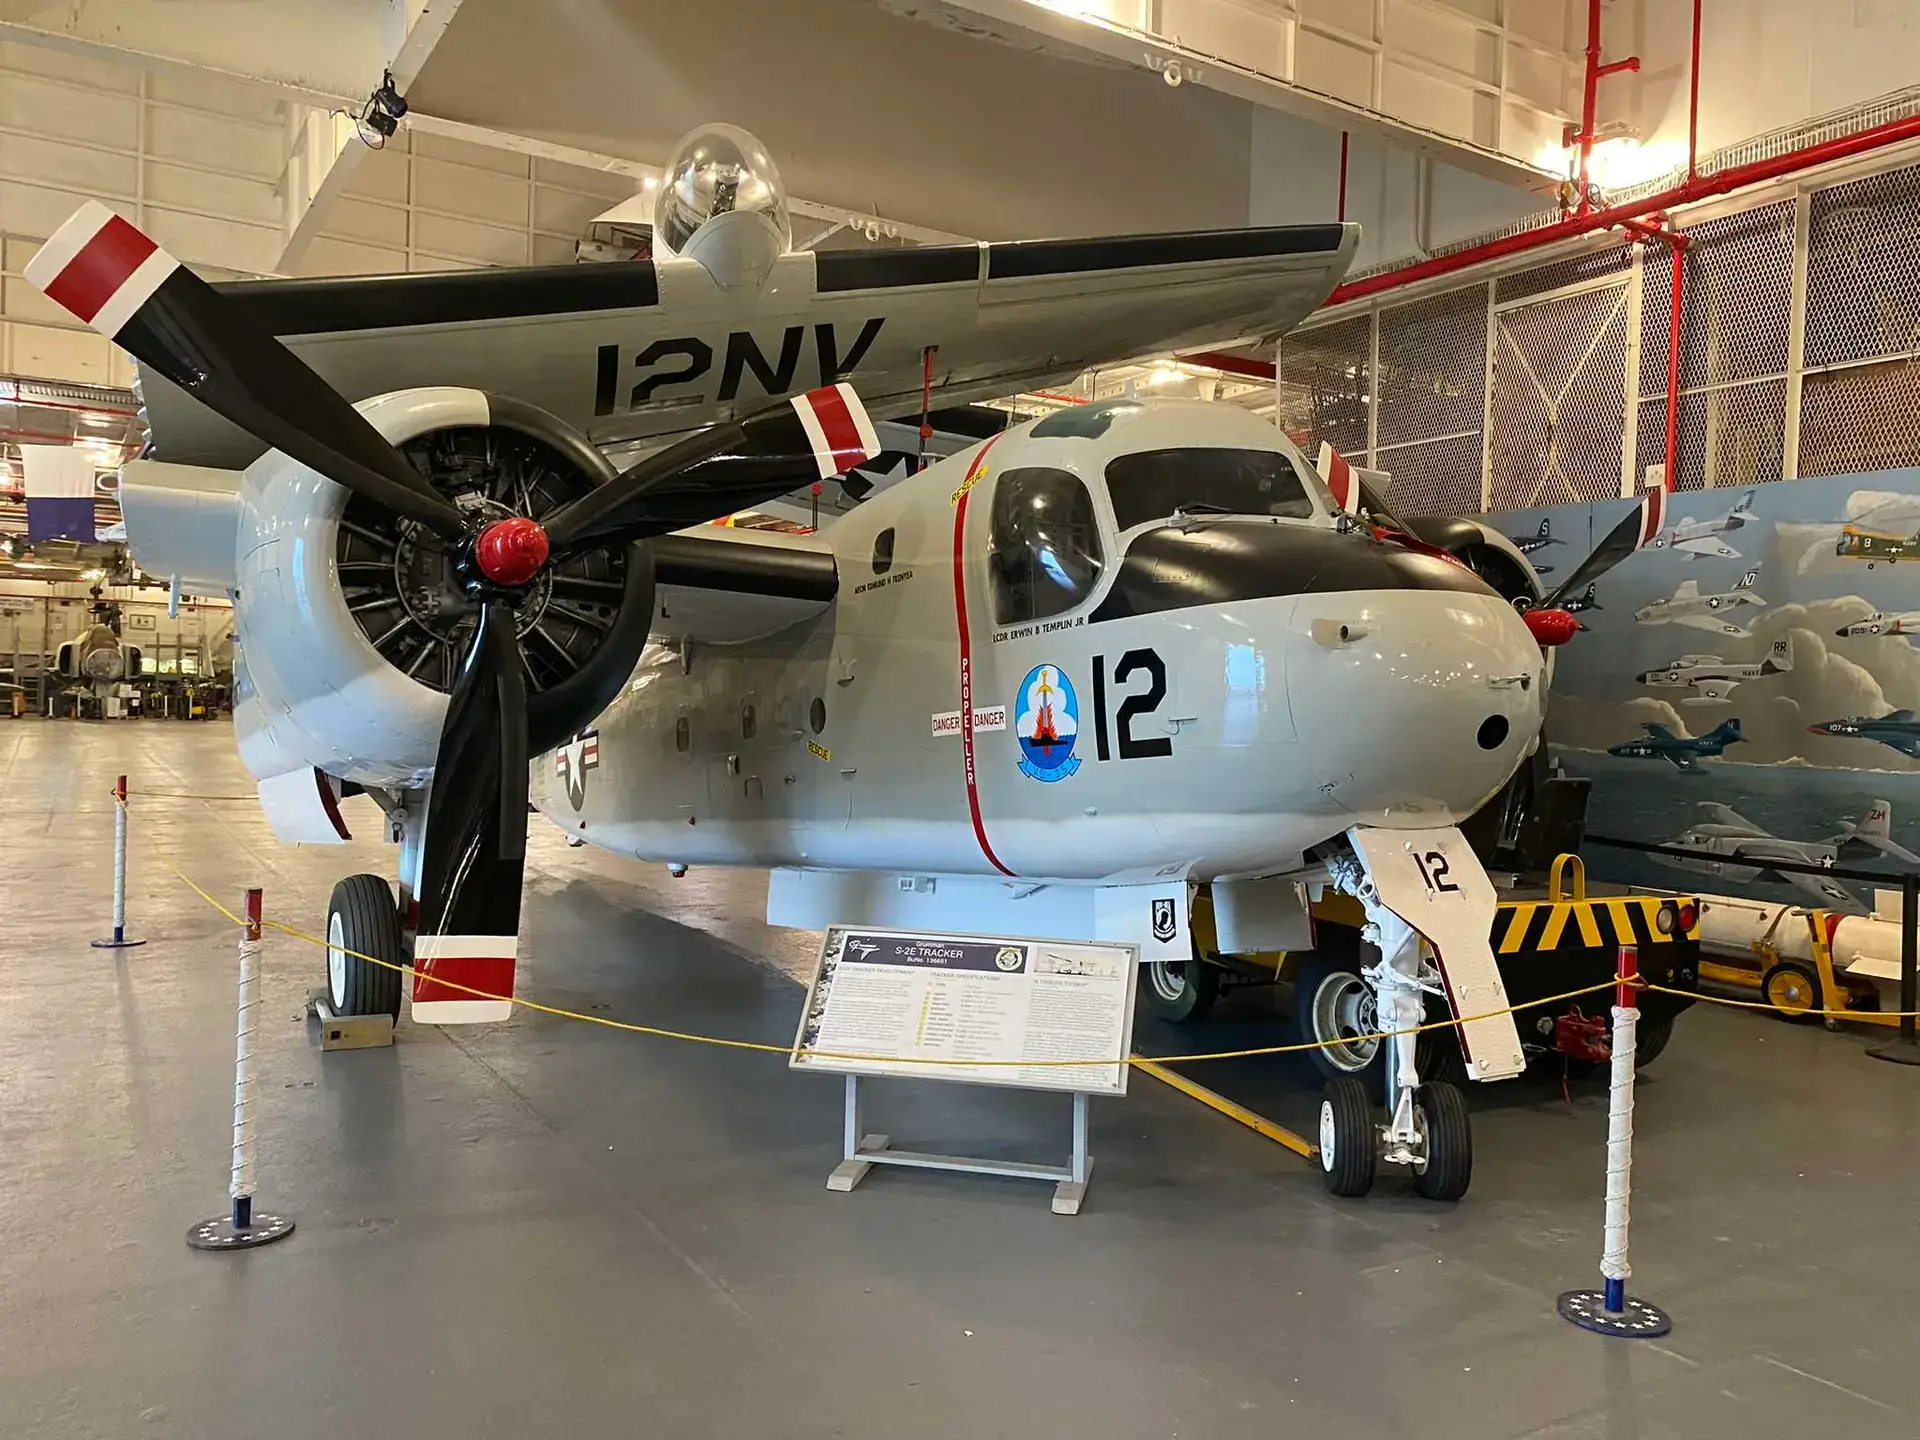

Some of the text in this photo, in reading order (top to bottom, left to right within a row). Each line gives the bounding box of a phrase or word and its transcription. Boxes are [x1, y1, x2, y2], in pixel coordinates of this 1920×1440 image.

[951, 467, 985, 505] RESCUE
[1541, 522, 1549, 535] S
[1864, 538, 1872, 548] 8
[1589, 585, 1595, 597] S
[992, 616, 1085, 643] LCDR ERWIN B TEMPLIN JR
[1774, 641, 1787, 652] RR
[1091, 647, 1173, 762] 12
[932, 711, 1005, 732] DANGER DANGER
[962, 658, 974, 785] PROPELLER
[1870, 809, 1886, 820] ZH
[1411, 851, 1460, 893] 12
[895, 946, 964, 958] S-2E TRACKER
